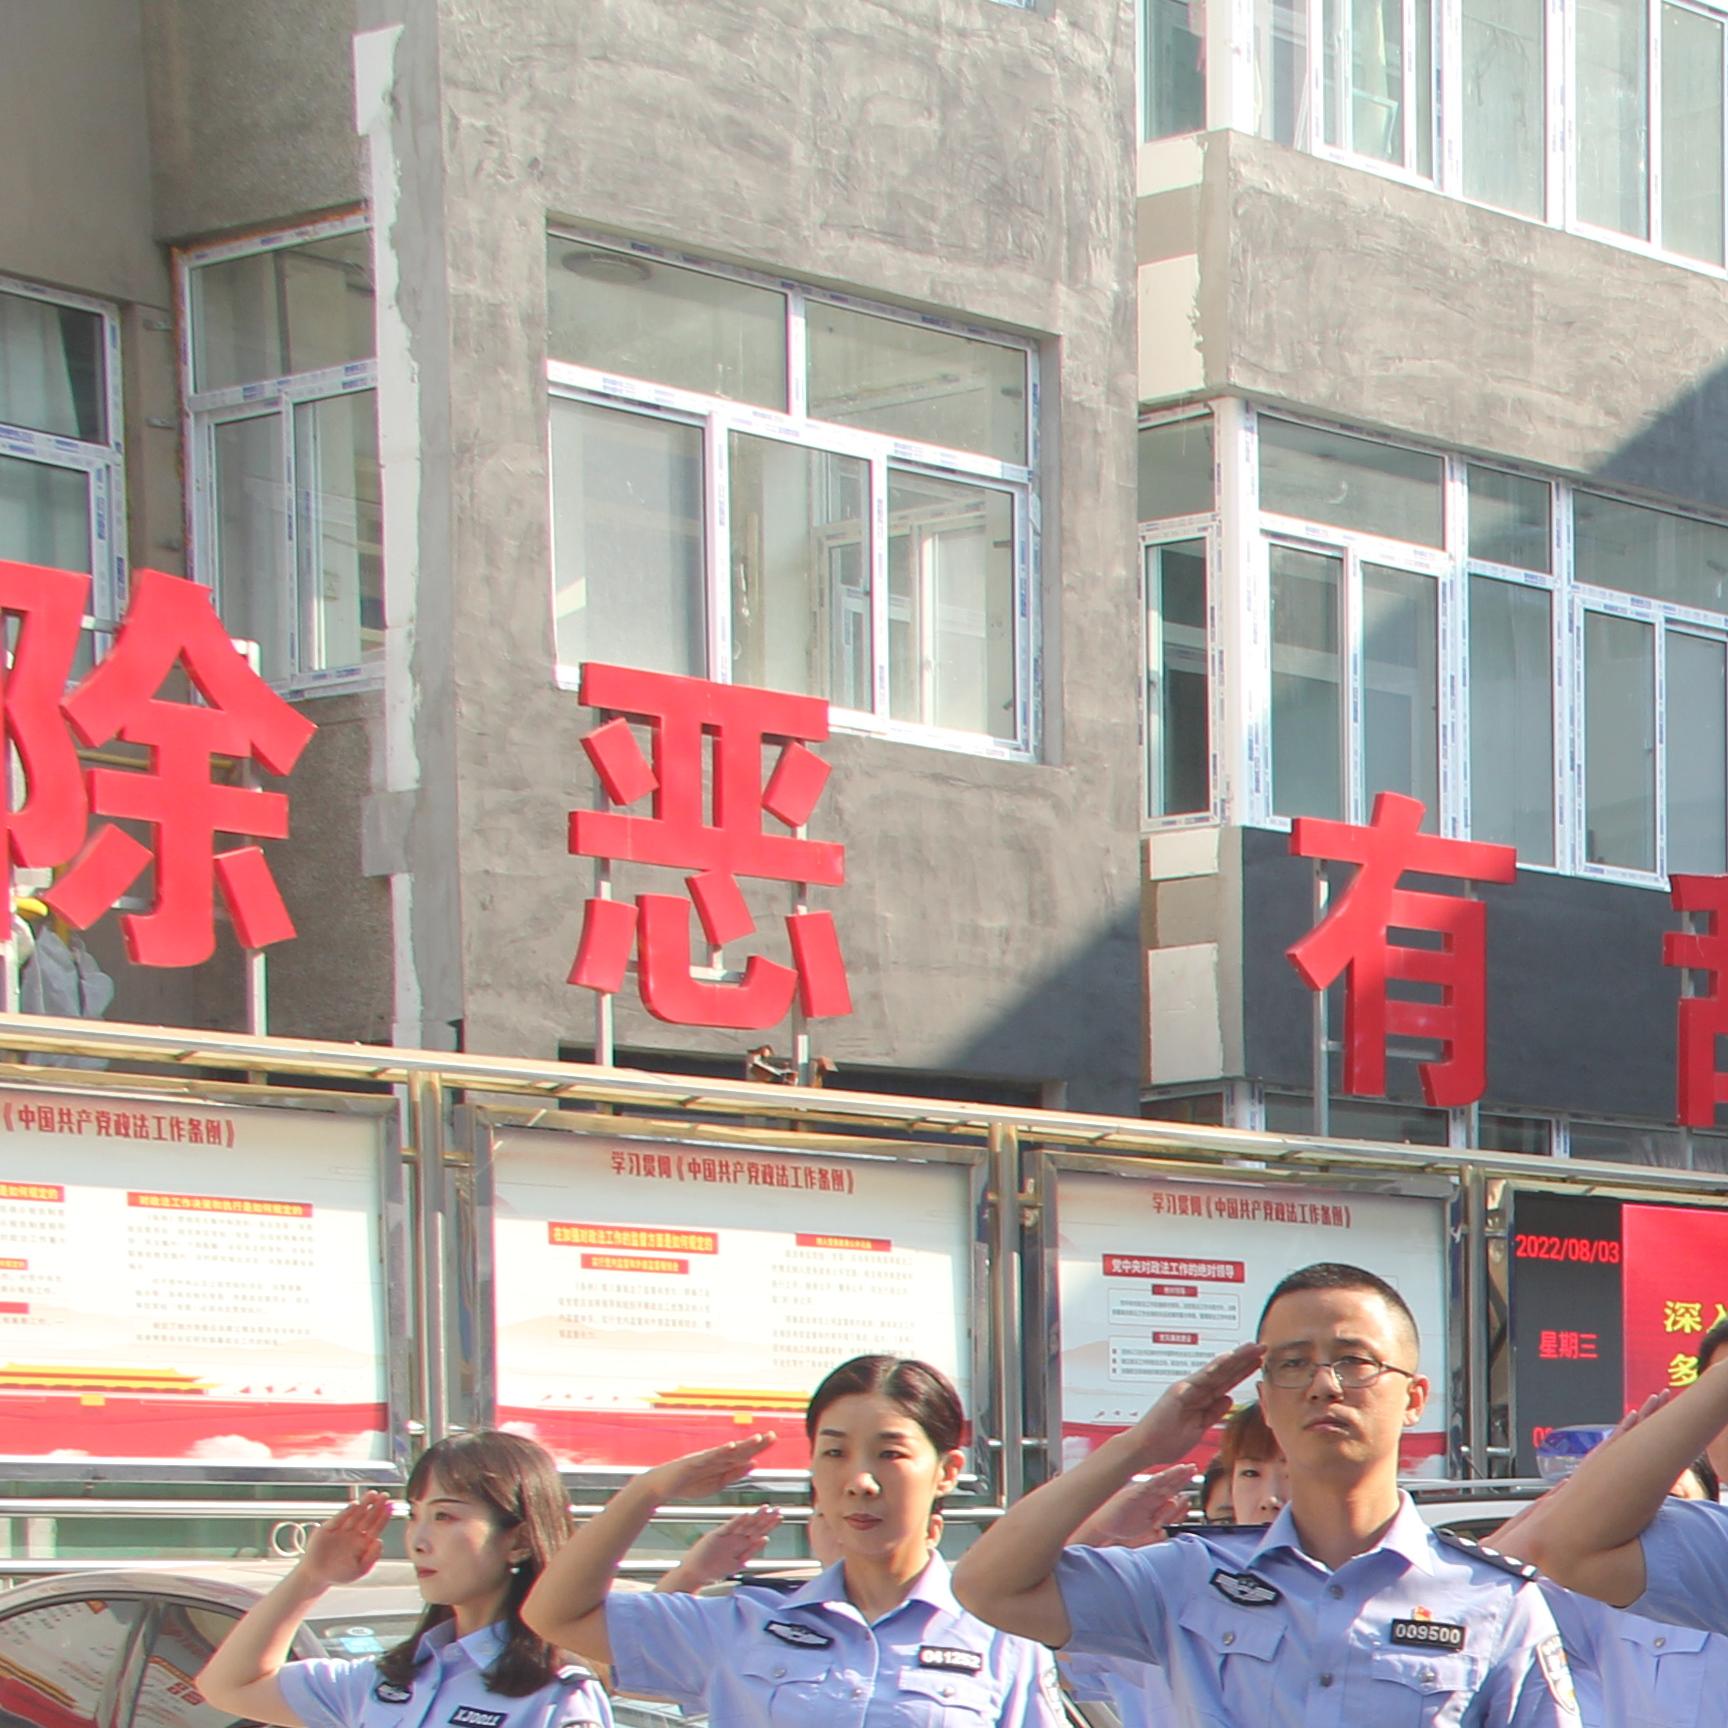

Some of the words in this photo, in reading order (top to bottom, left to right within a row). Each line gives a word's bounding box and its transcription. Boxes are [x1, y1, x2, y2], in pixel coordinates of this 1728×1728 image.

[0, 557, 853, 1031] 除恶
[1515, 1234, 1620, 1263] 2022/08/03
[1539, 1330, 1599, 1360] 星期三
[1394, 1623, 1463, 1645] 009500
